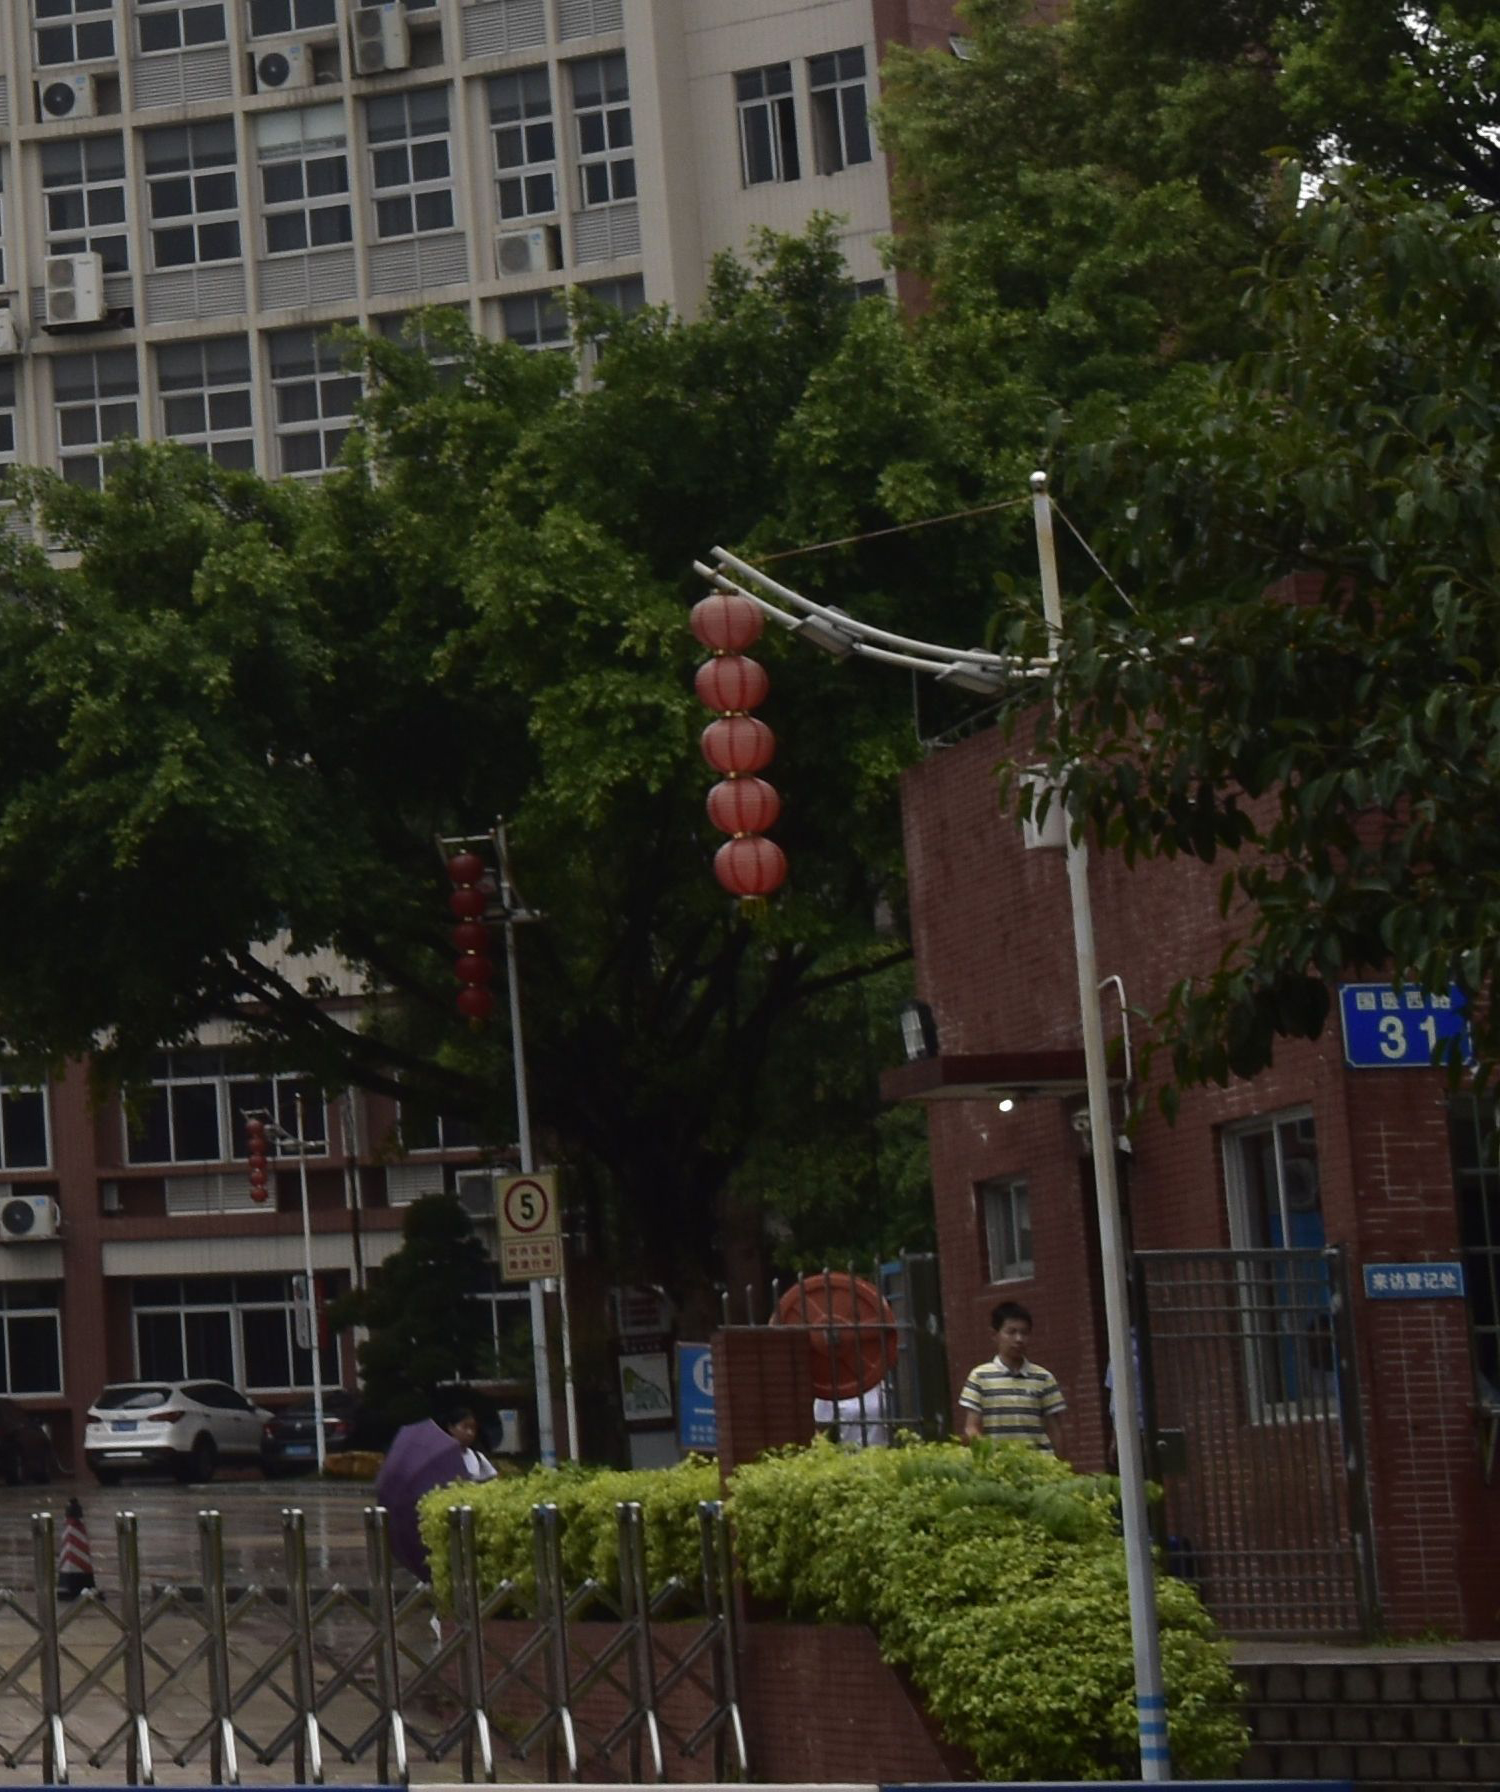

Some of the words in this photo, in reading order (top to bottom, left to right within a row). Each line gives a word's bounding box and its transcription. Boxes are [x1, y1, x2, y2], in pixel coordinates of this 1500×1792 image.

[1379, 1015, 1437, 1059] 31
[520, 1193, 535, 1221] 5
[1372, 1272, 1457, 1290] 来访登记处
